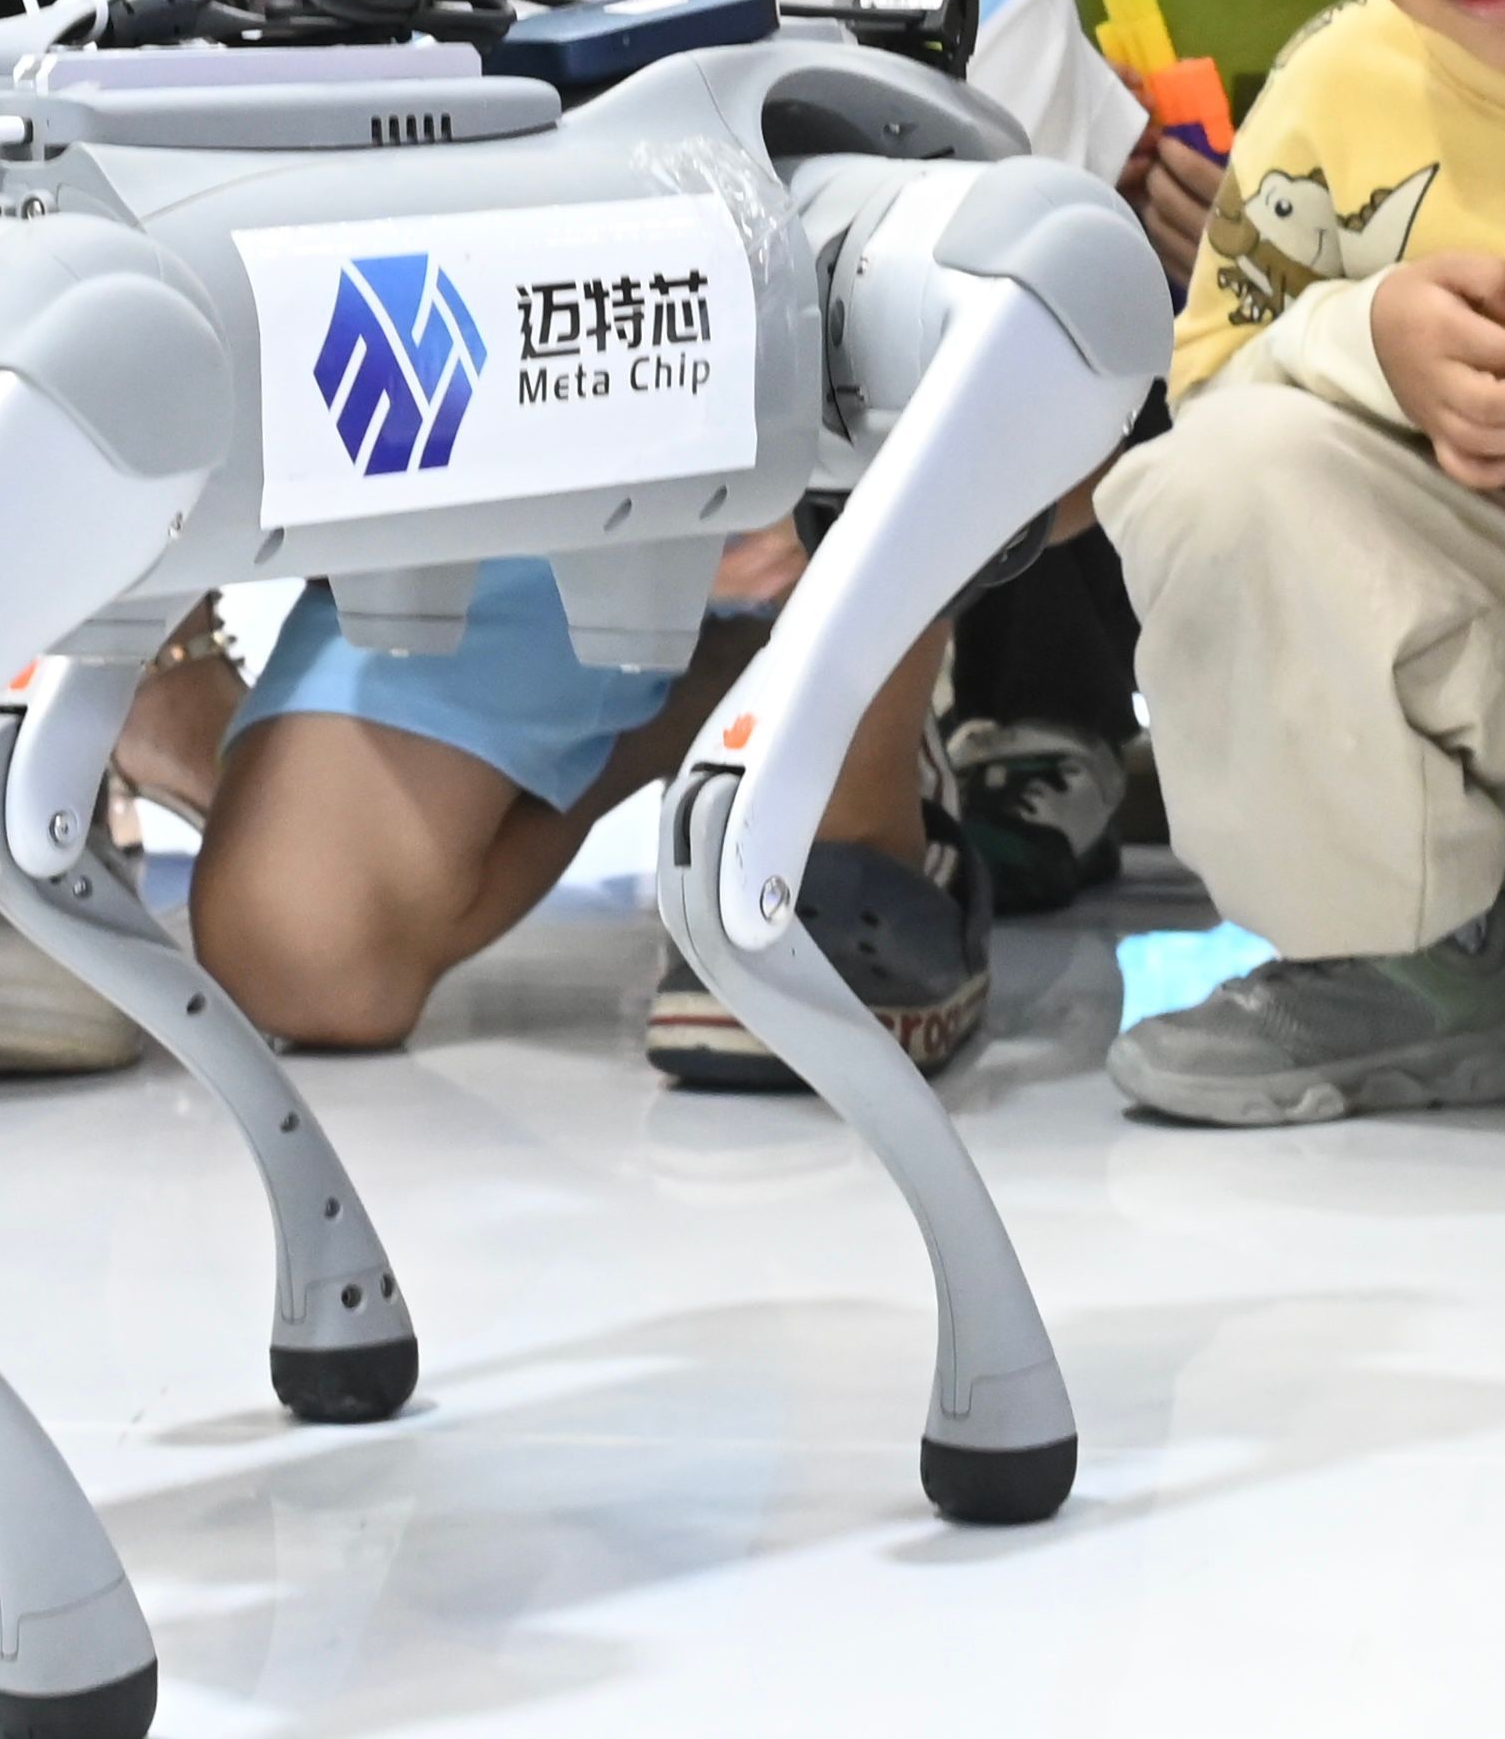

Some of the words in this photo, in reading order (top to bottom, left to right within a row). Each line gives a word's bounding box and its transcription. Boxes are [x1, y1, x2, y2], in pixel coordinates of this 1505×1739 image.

[516, 268, 711, 361] 迈特芯
[518, 362, 610, 405] Meta
[629, 352, 711, 395] Chip
